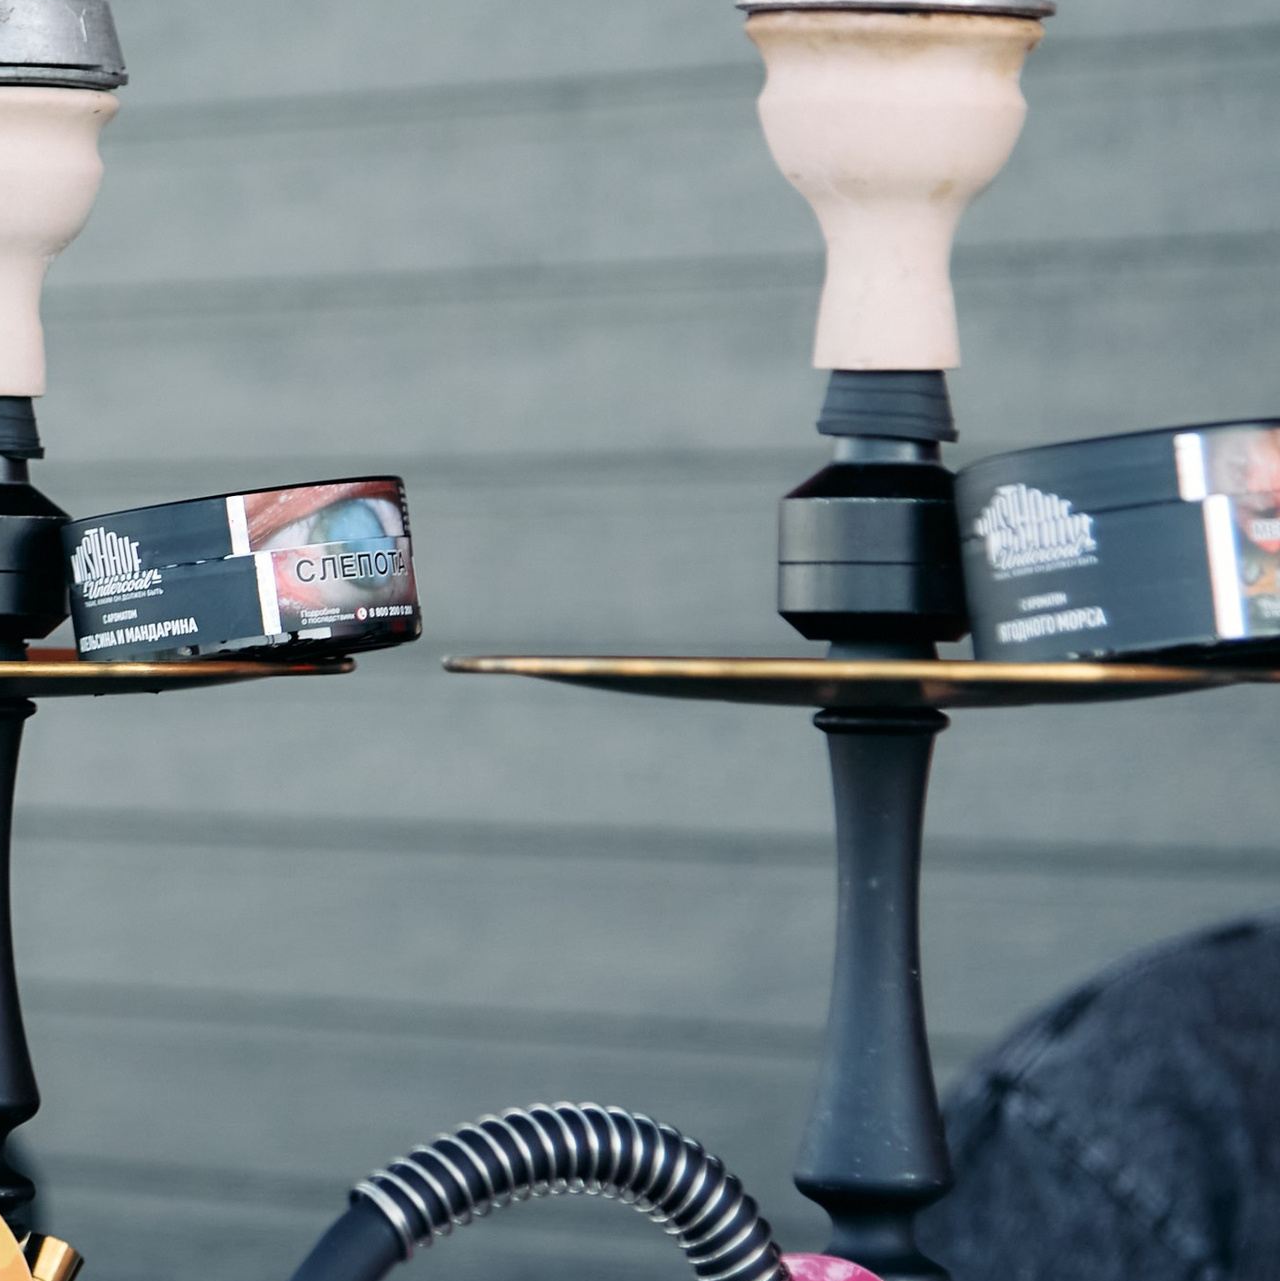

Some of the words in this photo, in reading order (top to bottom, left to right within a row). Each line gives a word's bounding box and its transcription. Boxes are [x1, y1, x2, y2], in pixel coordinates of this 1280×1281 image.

[295, 550, 408, 583] СЛЕПОТА
[125, 617, 199, 643] МАНДАРИНА
[1057, 606, 1107, 632] МОРСА
